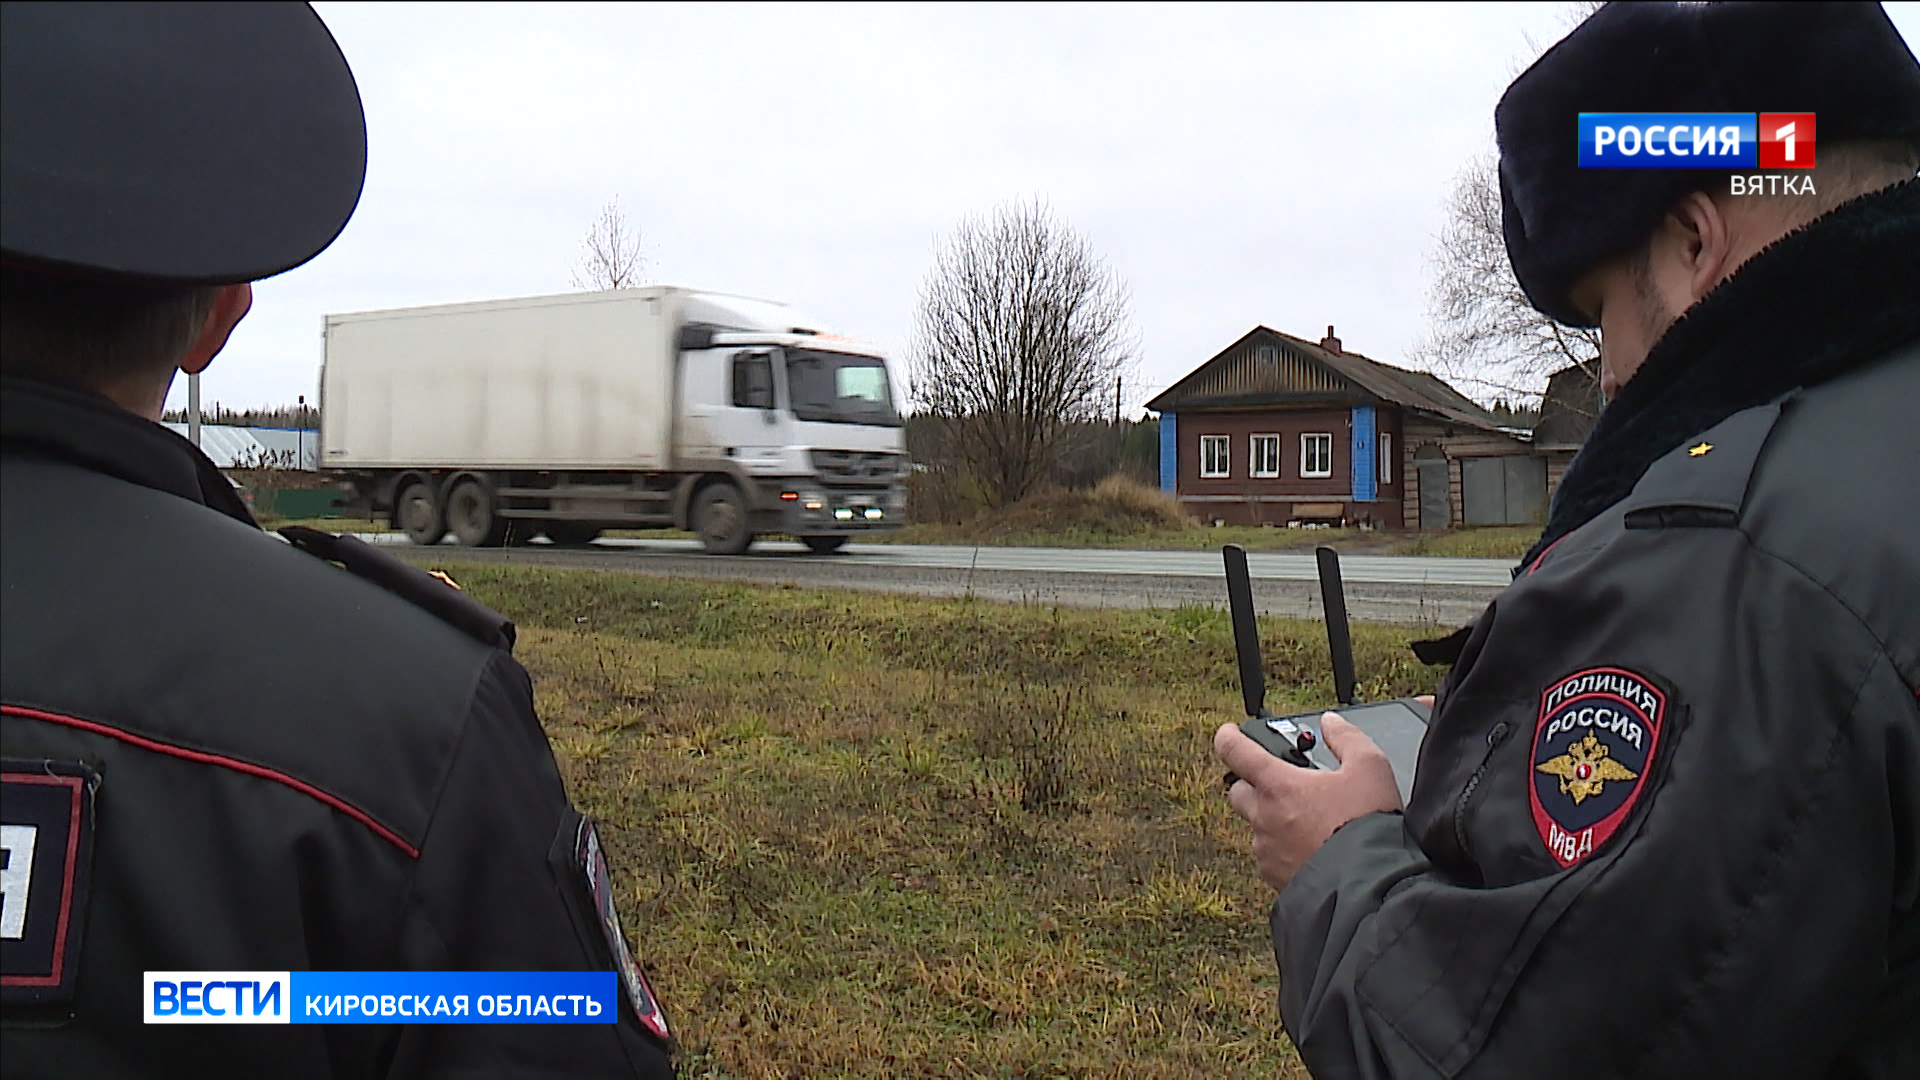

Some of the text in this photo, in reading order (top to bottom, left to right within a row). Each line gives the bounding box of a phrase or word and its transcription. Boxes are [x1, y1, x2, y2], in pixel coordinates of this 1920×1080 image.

[1546, 674, 1657, 721] ПОЛИЦИЯ
[1545, 707, 1643, 751] РОССИЯ
[1549, 823, 1593, 860] МВД
